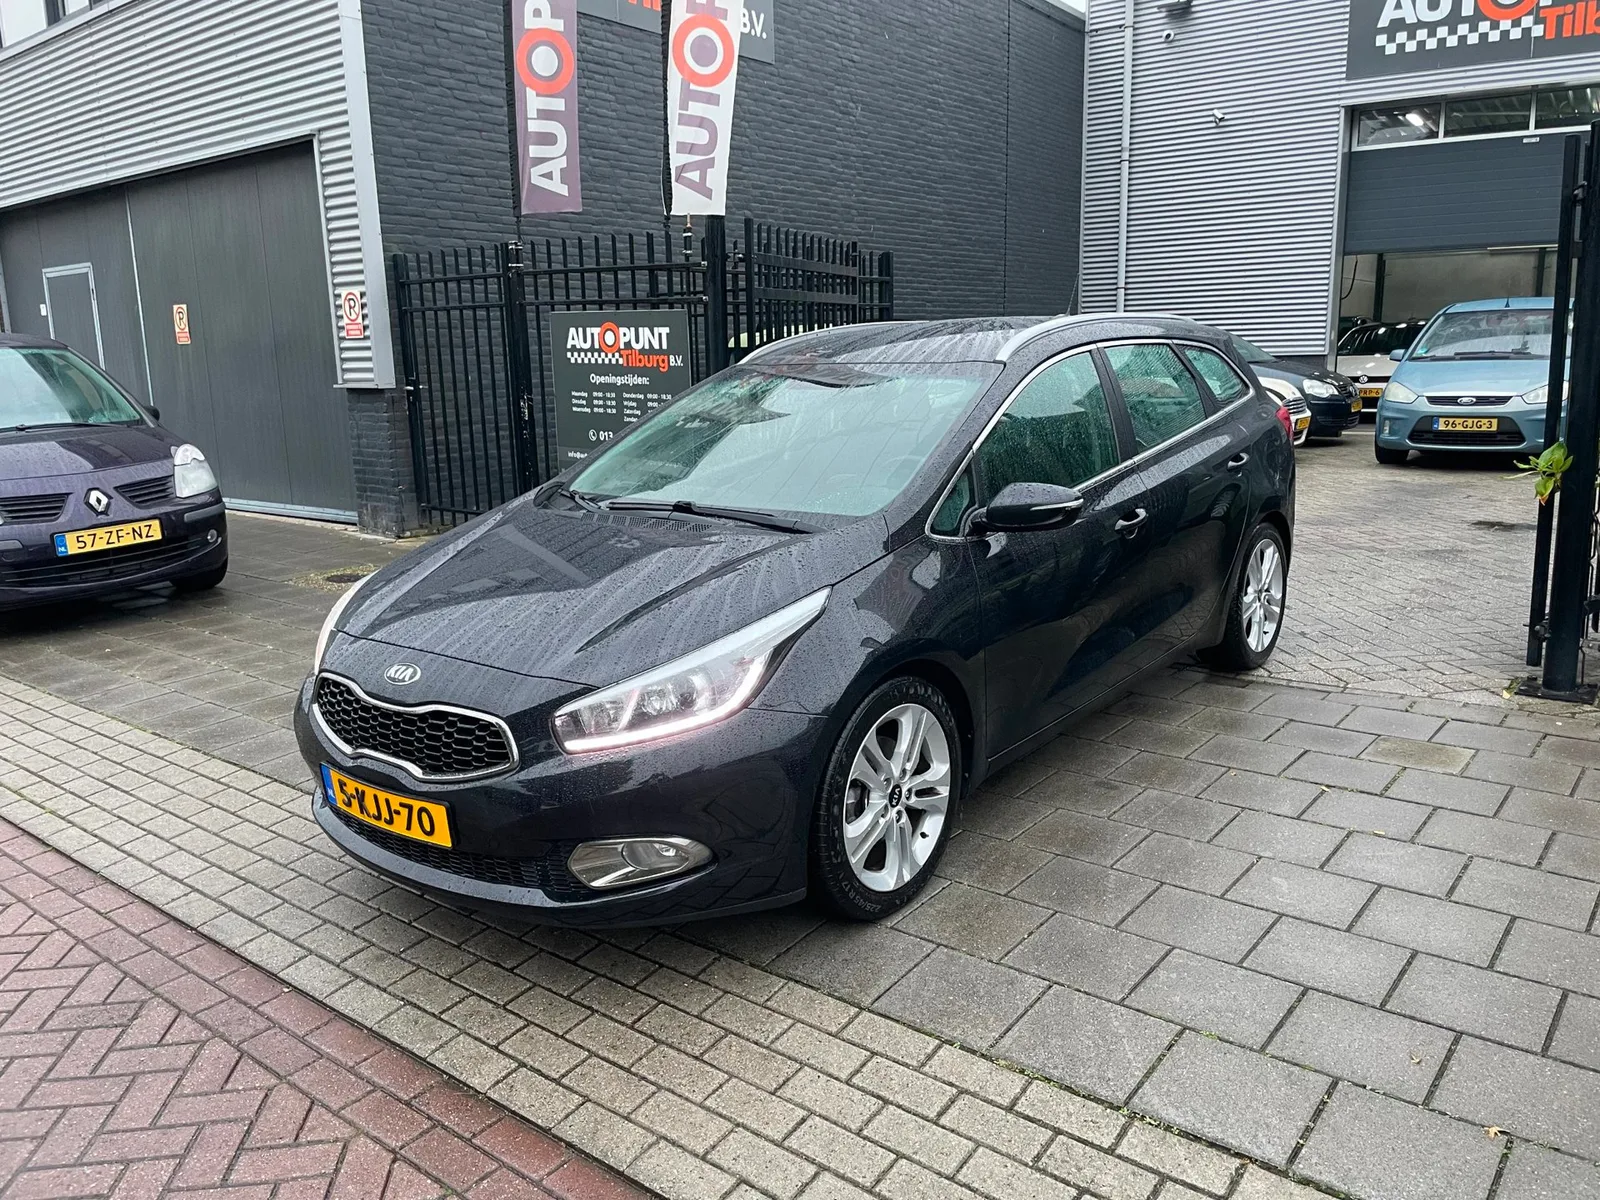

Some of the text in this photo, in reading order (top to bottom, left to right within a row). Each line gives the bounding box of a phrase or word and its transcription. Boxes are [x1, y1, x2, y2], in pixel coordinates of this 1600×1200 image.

[567, 322, 670, 353] AUTOPUNT
[620, 350, 684, 372] Tilburg B.V.
[590, 374, 650, 385] Openingstijden:
[1443, 419, 1493, 429] 96-GJG-3
[76, 524, 154, 550] 57-ZF-NZ
[386, 664, 411, 681] KIA
[337, 778, 435, 836] 5-KJJ-70
[891, 788, 900, 806] KIA
